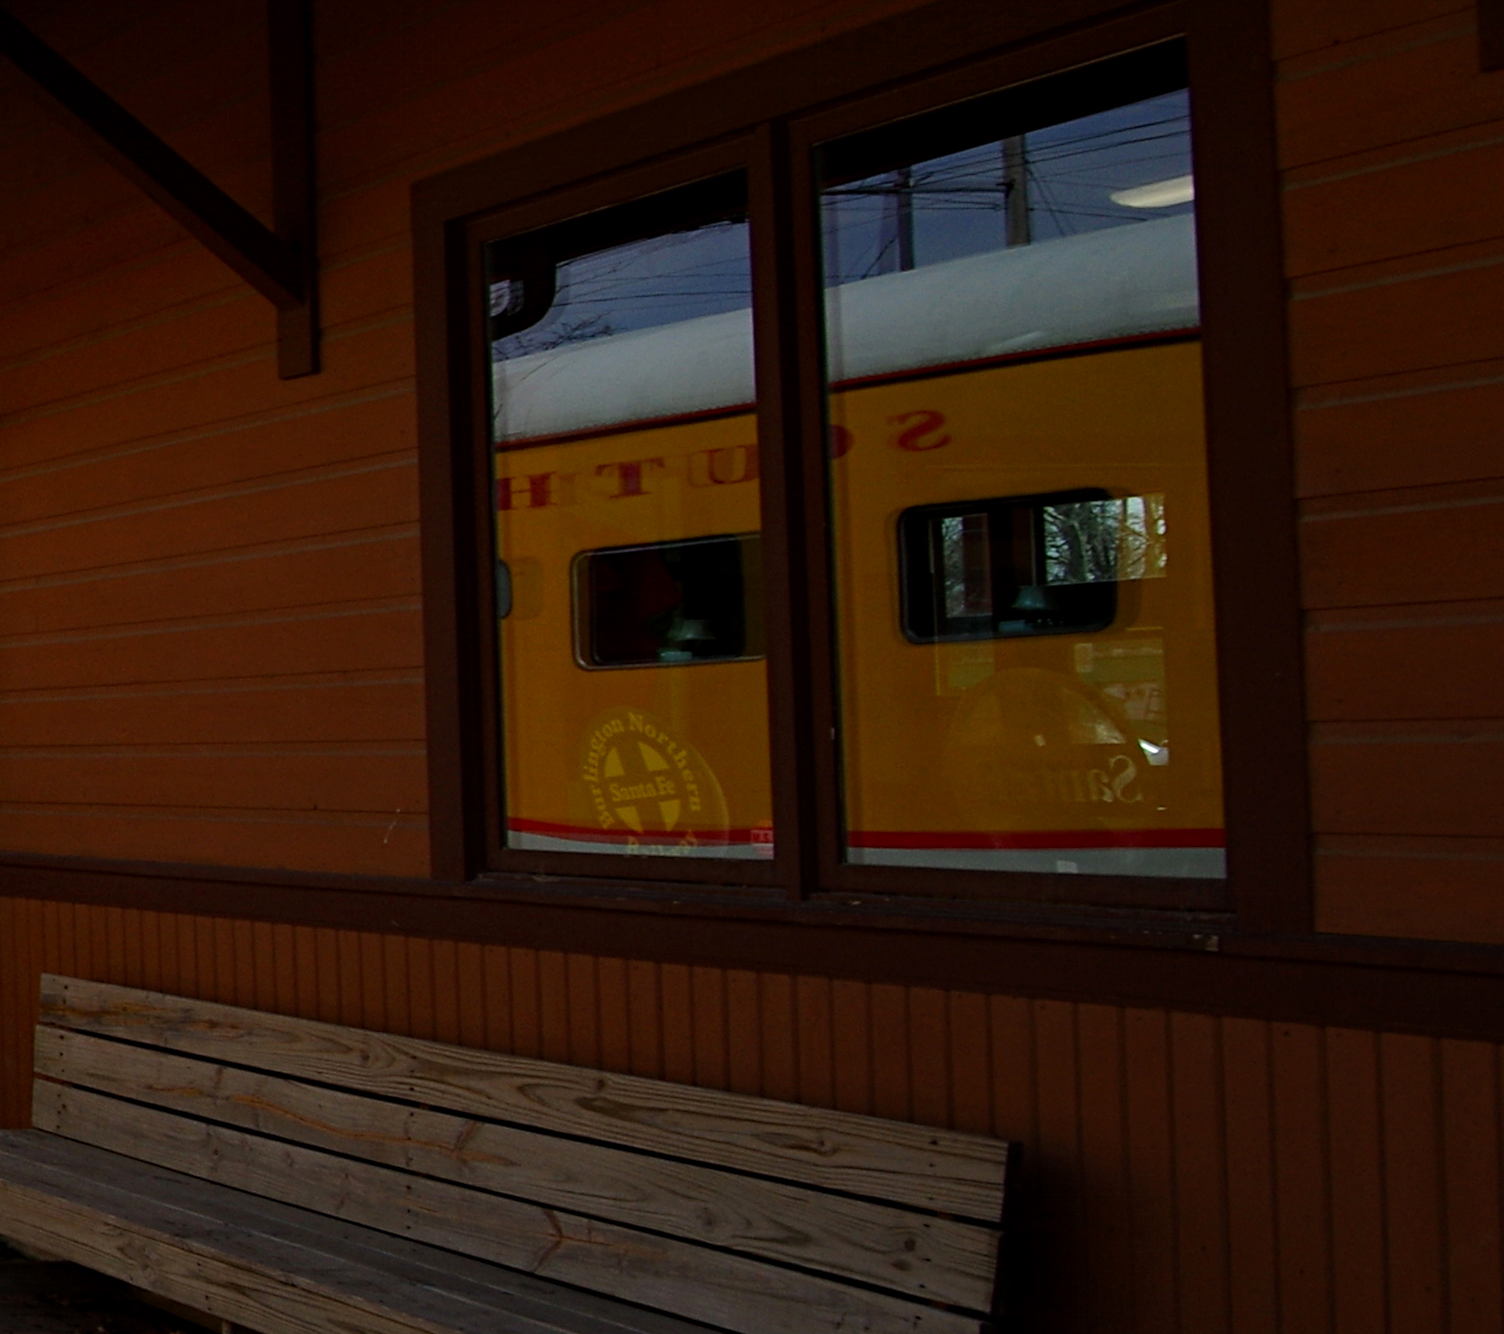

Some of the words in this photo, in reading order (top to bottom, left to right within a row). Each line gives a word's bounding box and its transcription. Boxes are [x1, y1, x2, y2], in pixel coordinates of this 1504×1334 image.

[583, 718, 625, 830] Burlington
[628, 711, 701, 812] Northern
[609, 780, 657, 802] Santa
[655, 775, 677, 795] Fe
